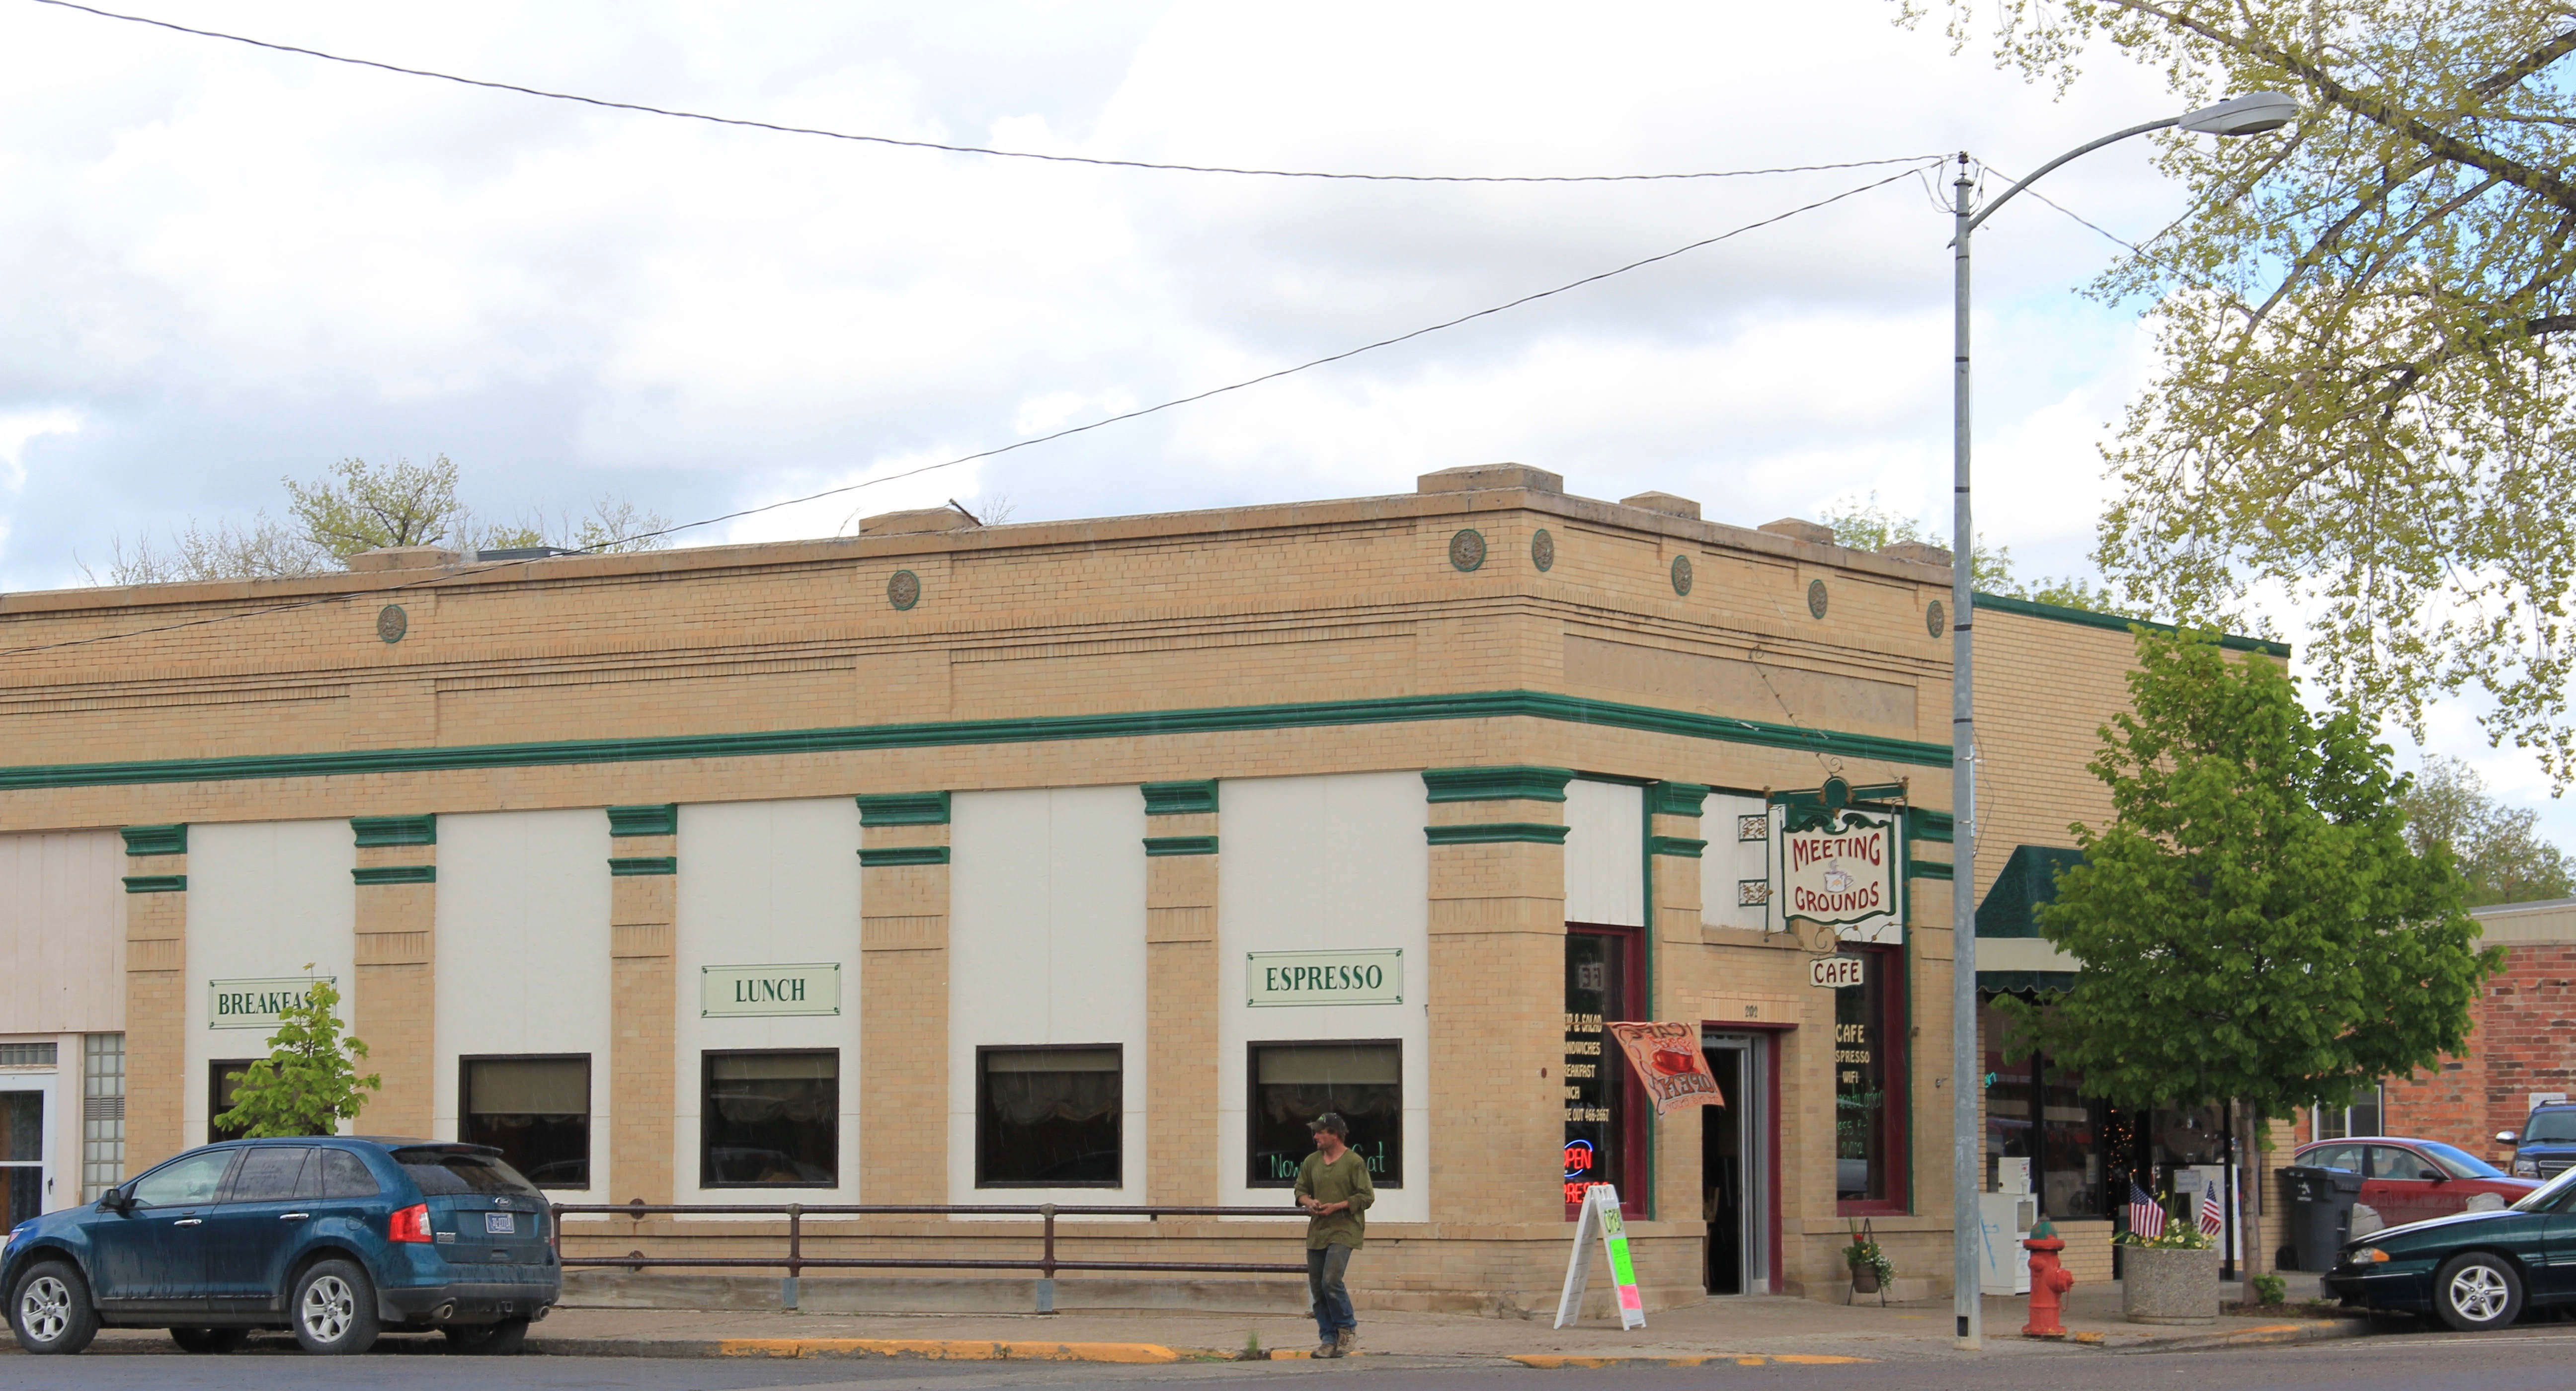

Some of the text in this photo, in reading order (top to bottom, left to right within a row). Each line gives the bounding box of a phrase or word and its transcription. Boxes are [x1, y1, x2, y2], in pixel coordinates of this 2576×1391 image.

[1792, 832, 1880, 873] MEETING
[1795, 880, 1879, 912] GROUNDS
[1266, 964, 1383, 992] ESPRESSO
[1814, 962, 1859, 984] CAFE
[735, 978, 805, 1003] LUNCH
[218, 991, 314, 1015] BREAKFAS
[1745, 1005, 1758, 1018] 202
[1574, 1013, 1581, 1032] &
[1582, 1013, 1603, 1033] SALAD
[1835, 1024, 1864, 1043] CAFE
[1835, 1050, 1870, 1064] SPRESSO
[1843, 1071, 1858, 1083] WIFI
[1573, 1108, 1584, 1122] OUT
[1585, 1108, 1610, 1122] 466-2667
[1351, 1141, 1386, 1172] at
[1564, 1148, 1593, 1169] PEN
